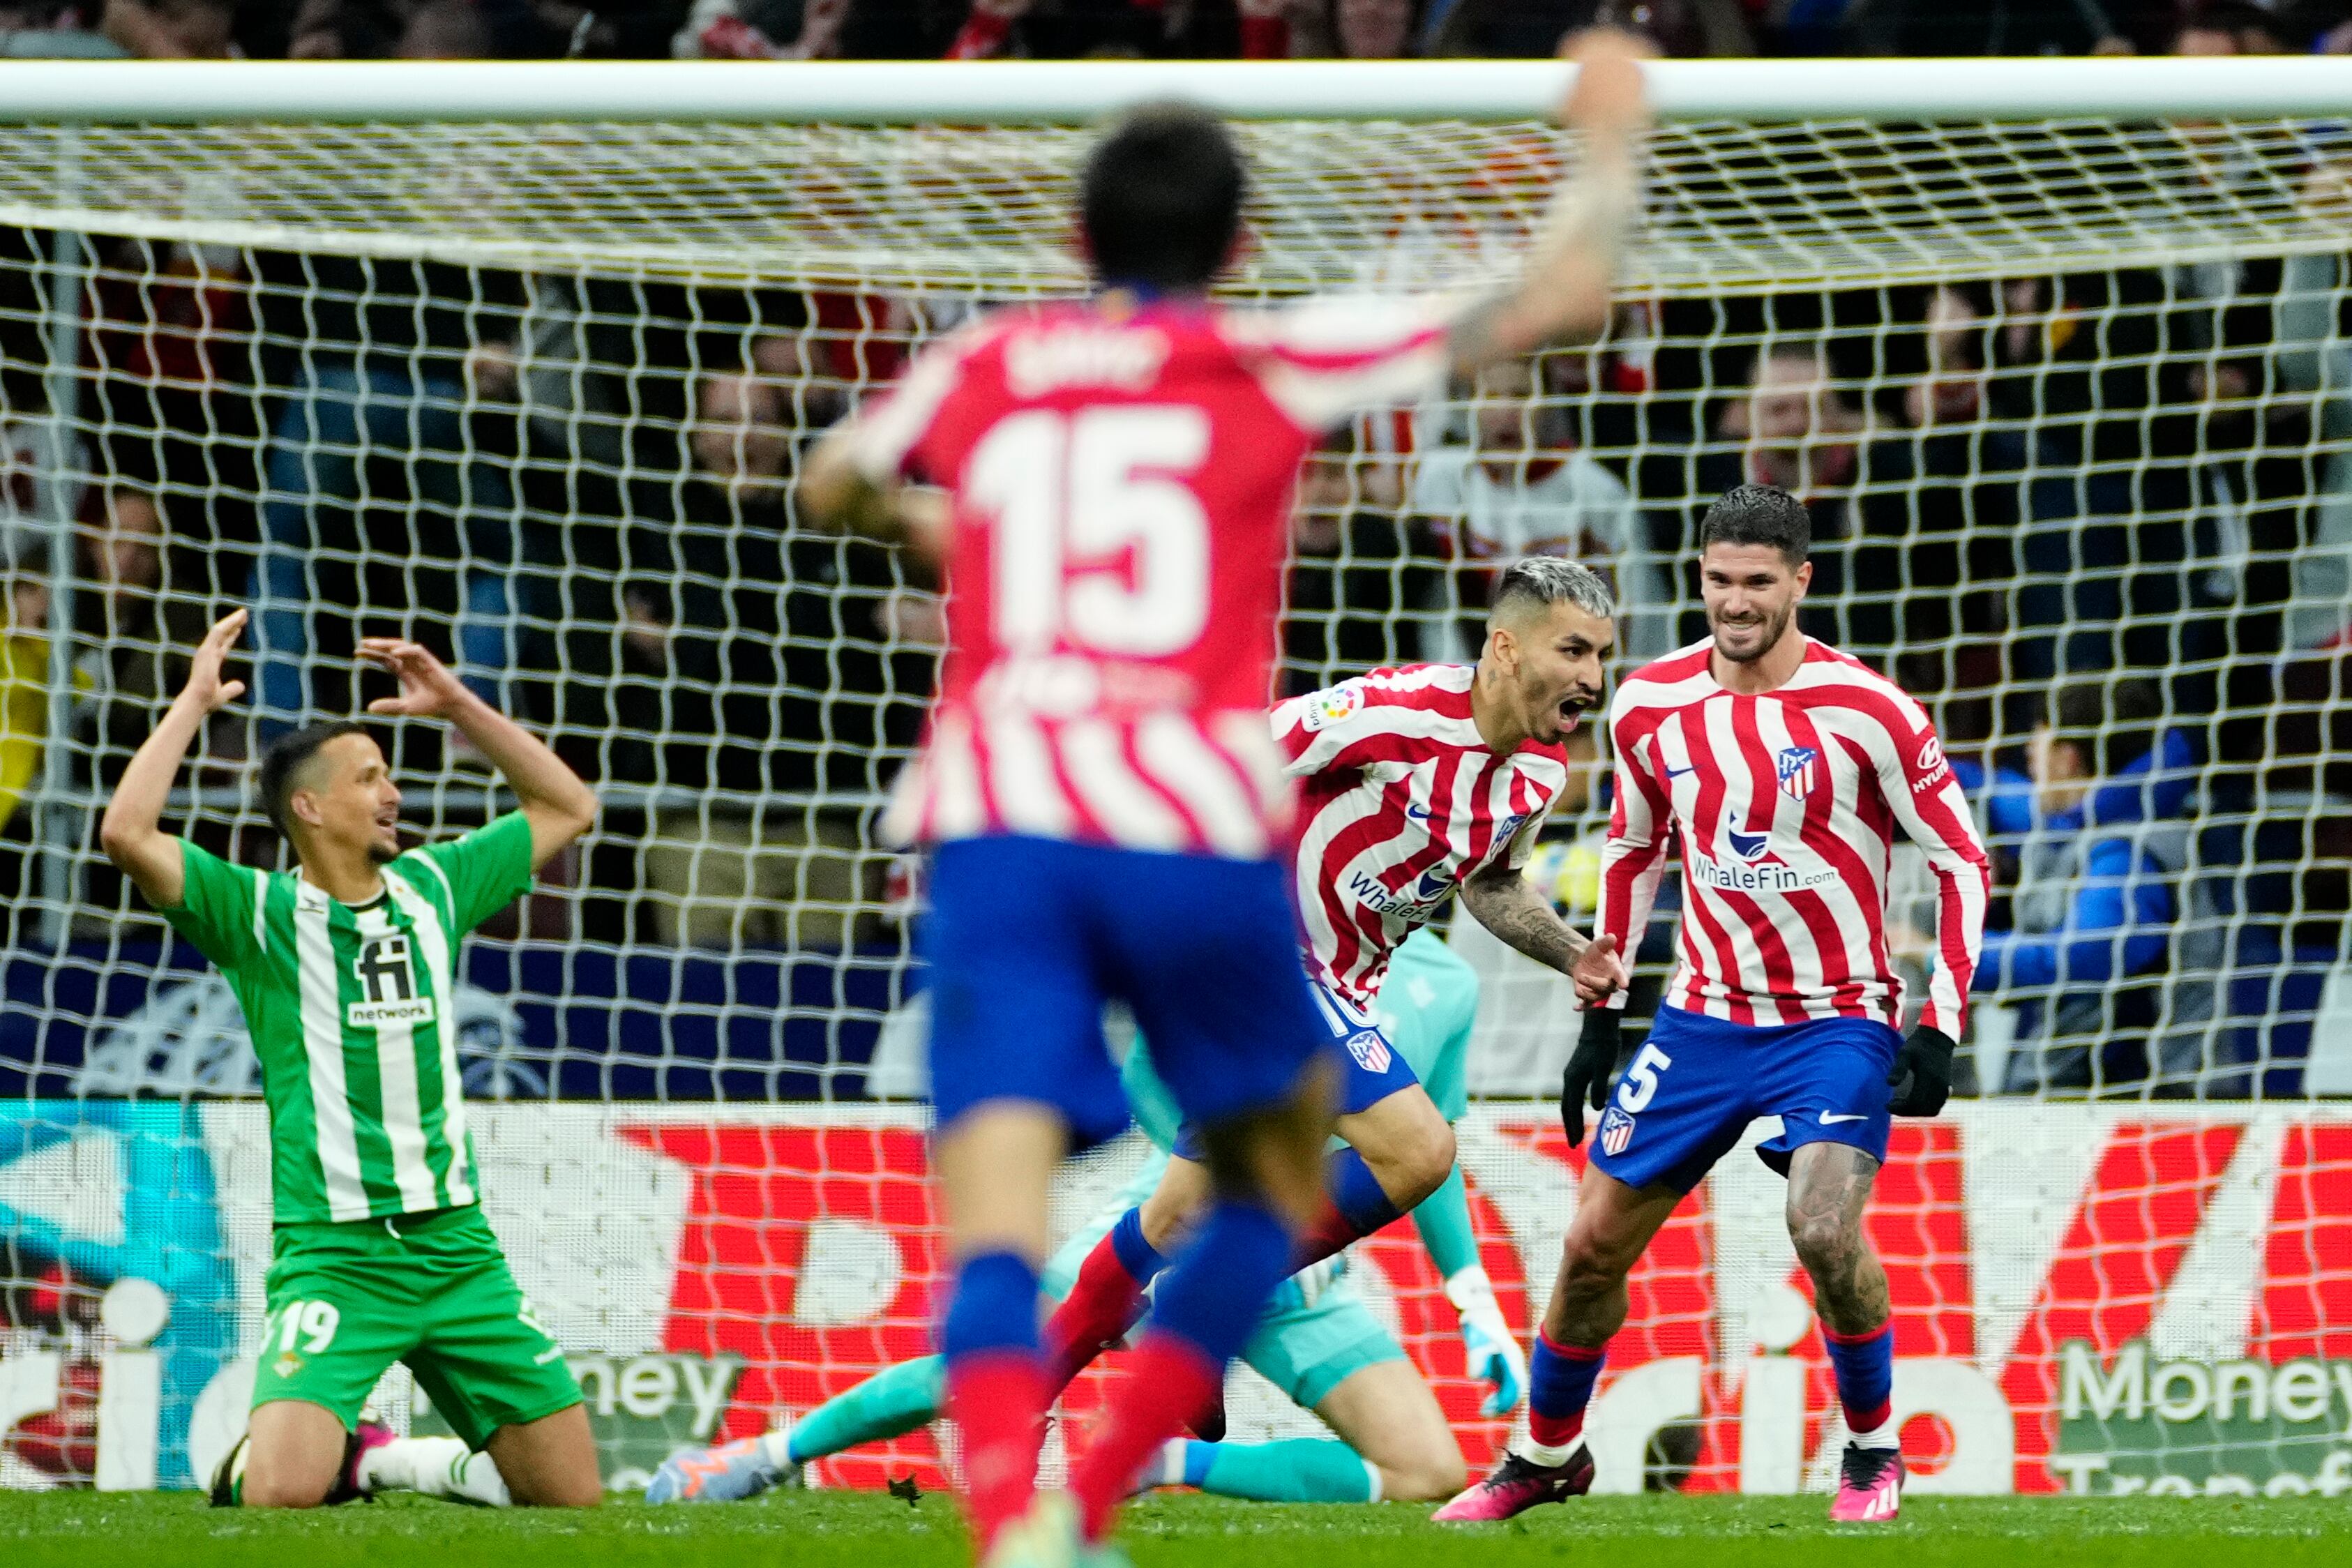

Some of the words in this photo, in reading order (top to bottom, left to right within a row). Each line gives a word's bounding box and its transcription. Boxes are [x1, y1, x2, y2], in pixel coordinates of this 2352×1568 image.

[961, 403, 1211, 656] 15
[1694, 854, 1836, 889] WhaleFin.com
[354, 1004, 428, 1022] network
[1618, 1043, 1672, 1114] 5
[280, 1299, 341, 1355] 19
[571, 1356, 735, 1438] ney
